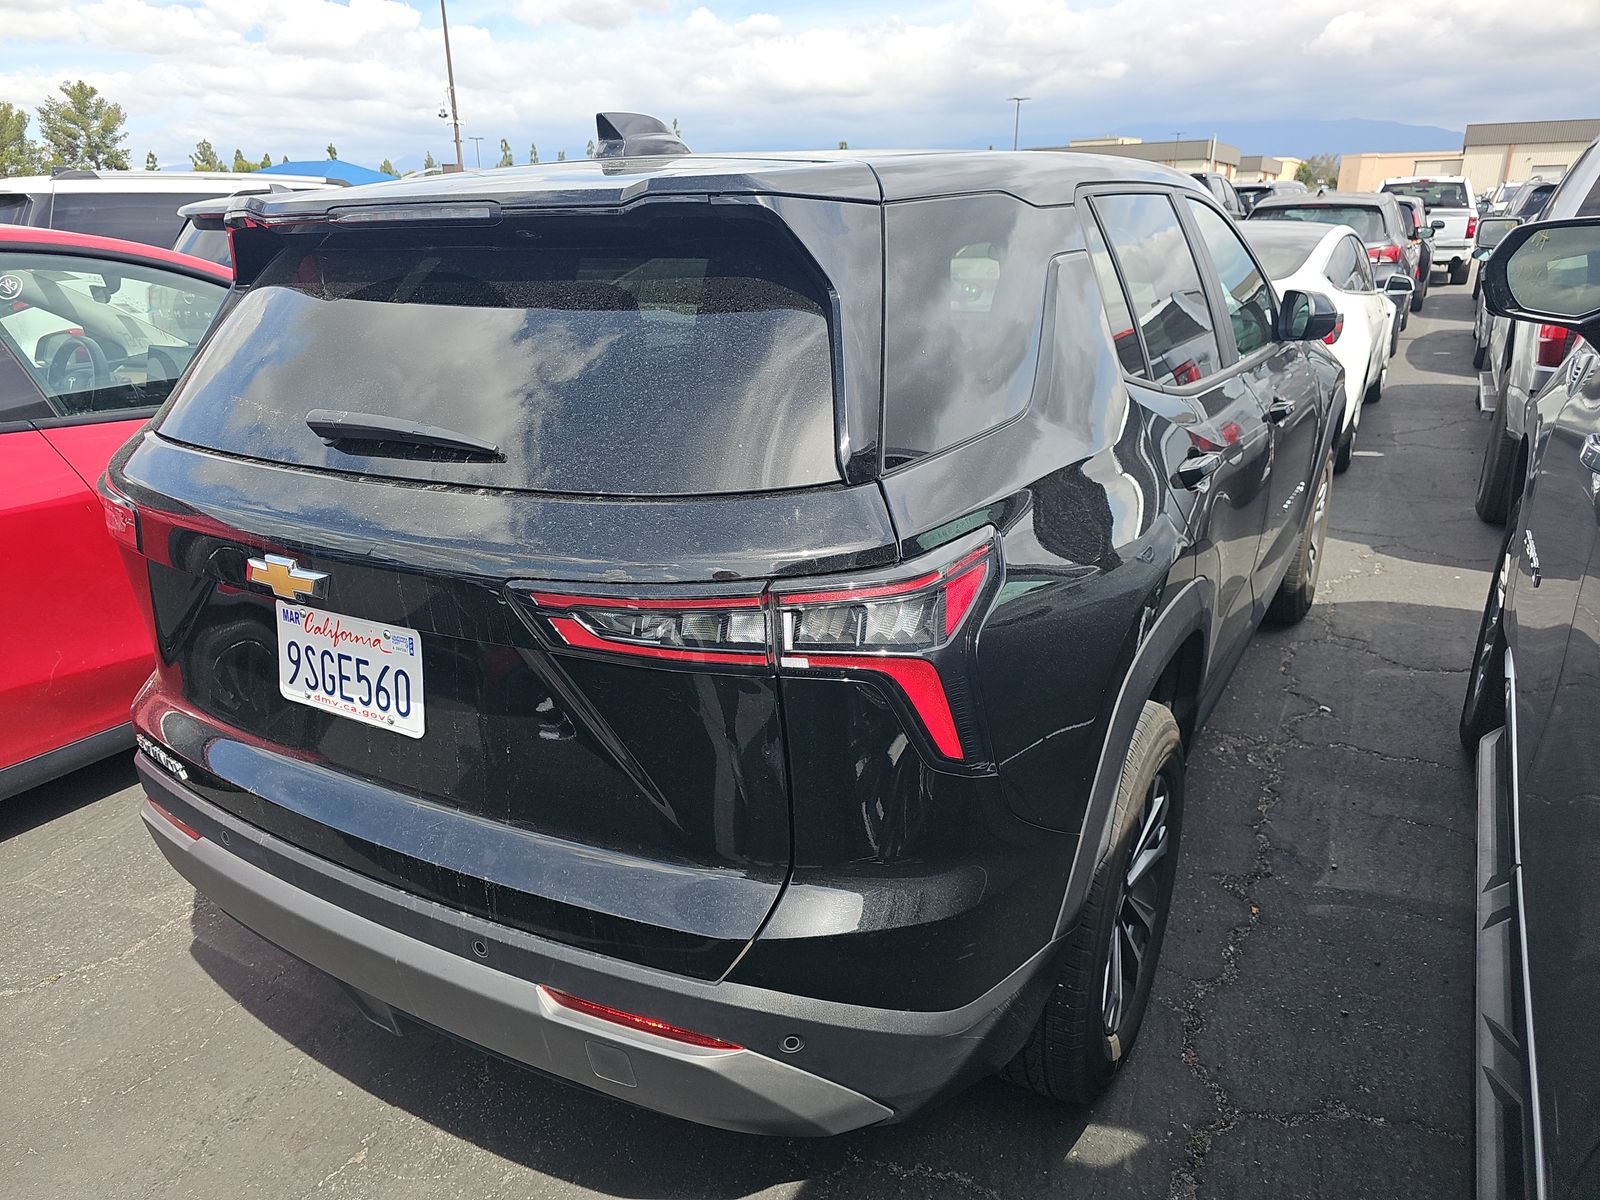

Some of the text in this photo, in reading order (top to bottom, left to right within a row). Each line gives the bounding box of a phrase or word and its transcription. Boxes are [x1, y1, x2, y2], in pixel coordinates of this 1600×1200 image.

[282, 608, 300, 625] MAR
[304, 611, 393, 654] California
[287, 640, 411, 718] 9SGE560
[313, 694, 386, 721] dmv.ca.gov
